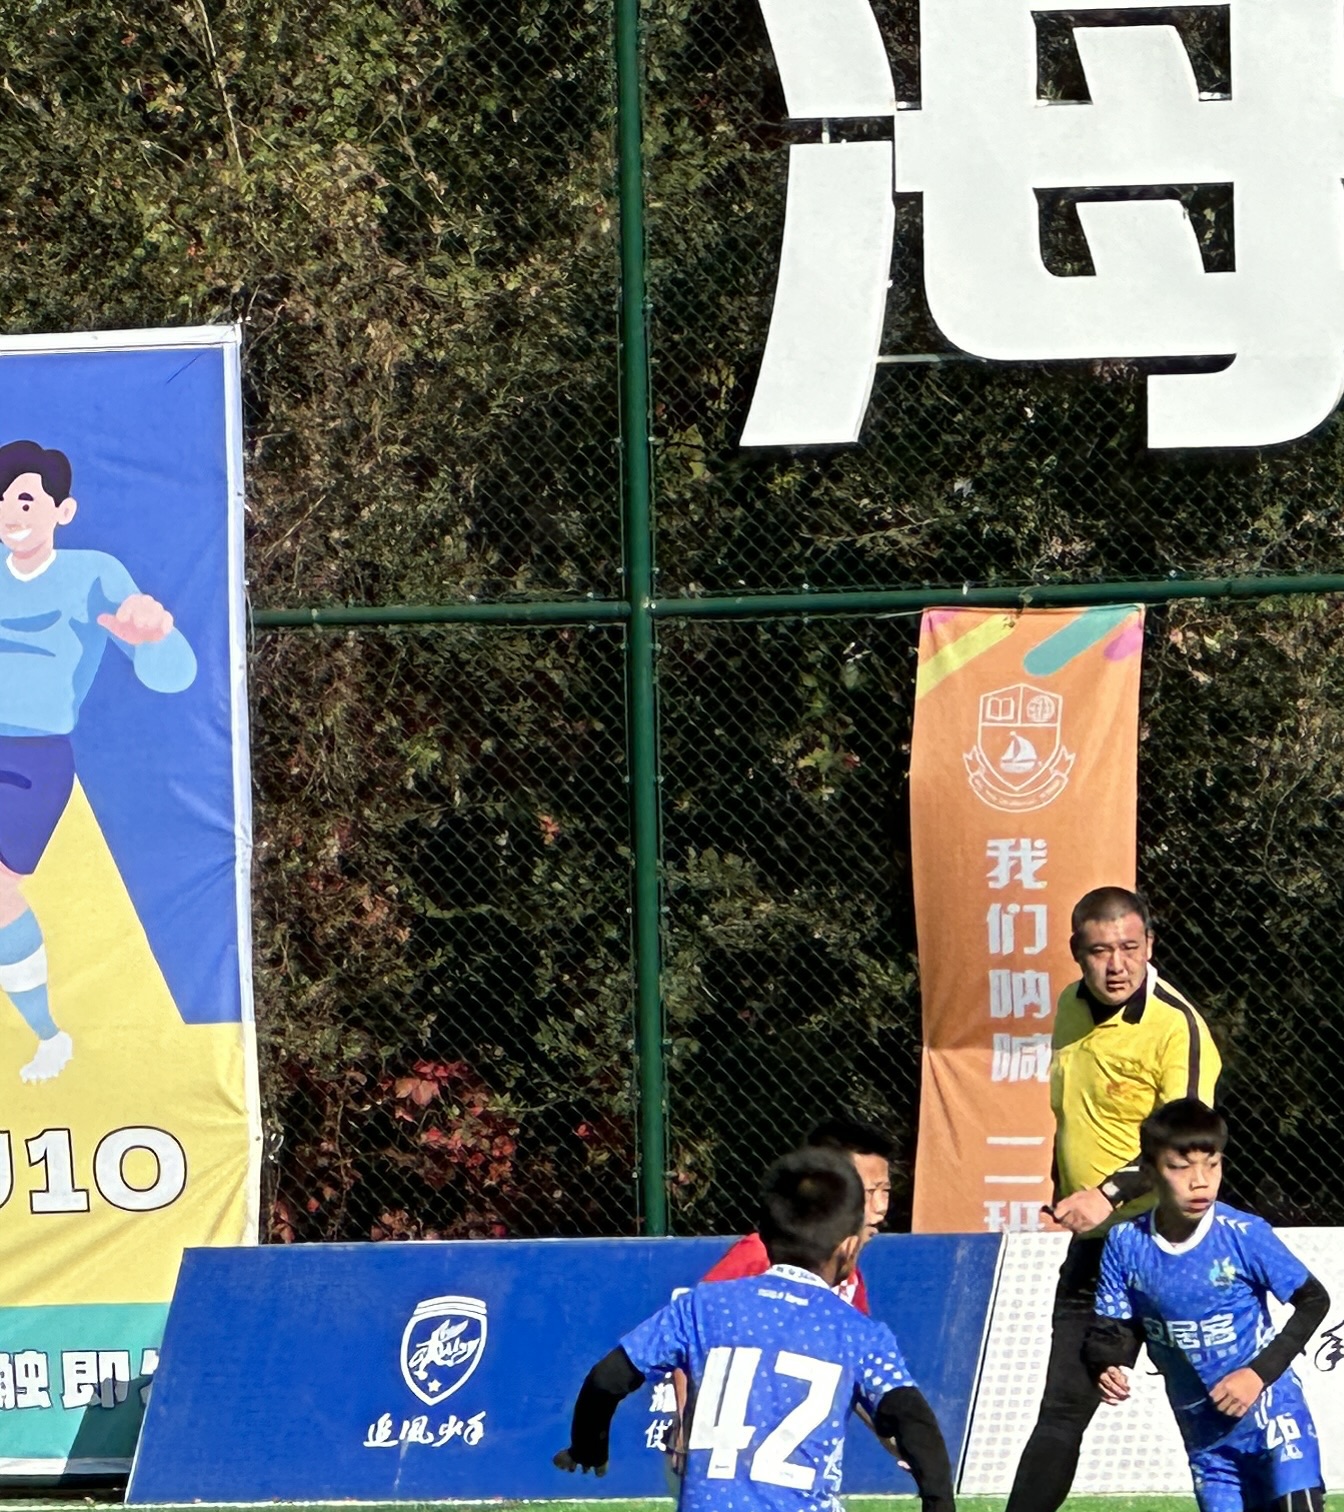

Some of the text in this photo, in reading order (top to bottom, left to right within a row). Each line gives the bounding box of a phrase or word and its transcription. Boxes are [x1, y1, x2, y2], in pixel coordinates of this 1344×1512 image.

[985, 837, 1052, 1084] 我们呐喊
[0, 1348, 159, 1411] 触即
[688, 1346, 843, 1491] 42
